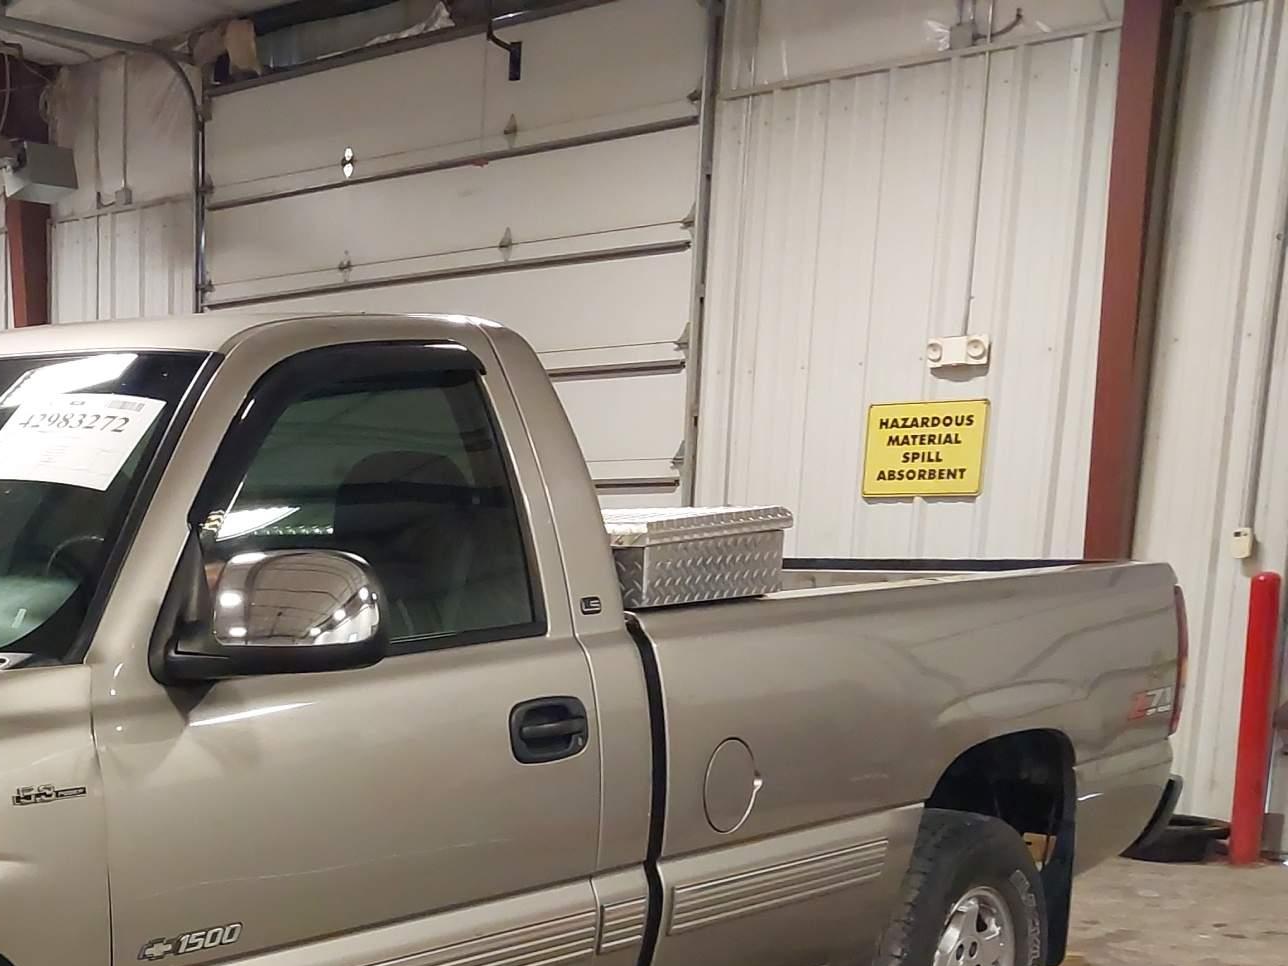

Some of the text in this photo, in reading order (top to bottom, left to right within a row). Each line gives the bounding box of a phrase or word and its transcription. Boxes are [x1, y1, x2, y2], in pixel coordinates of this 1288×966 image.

[19, 412, 130, 433] 42983272
[879, 414, 974, 429] HAZARDOUS
[886, 433, 962, 446] MATERIAL
[901, 451, 943, 463] SPILL
[876, 468, 967, 481] ABSORBENT
[1128, 686, 1172, 721] Z71
[177, 922, 244, 955] 1500
